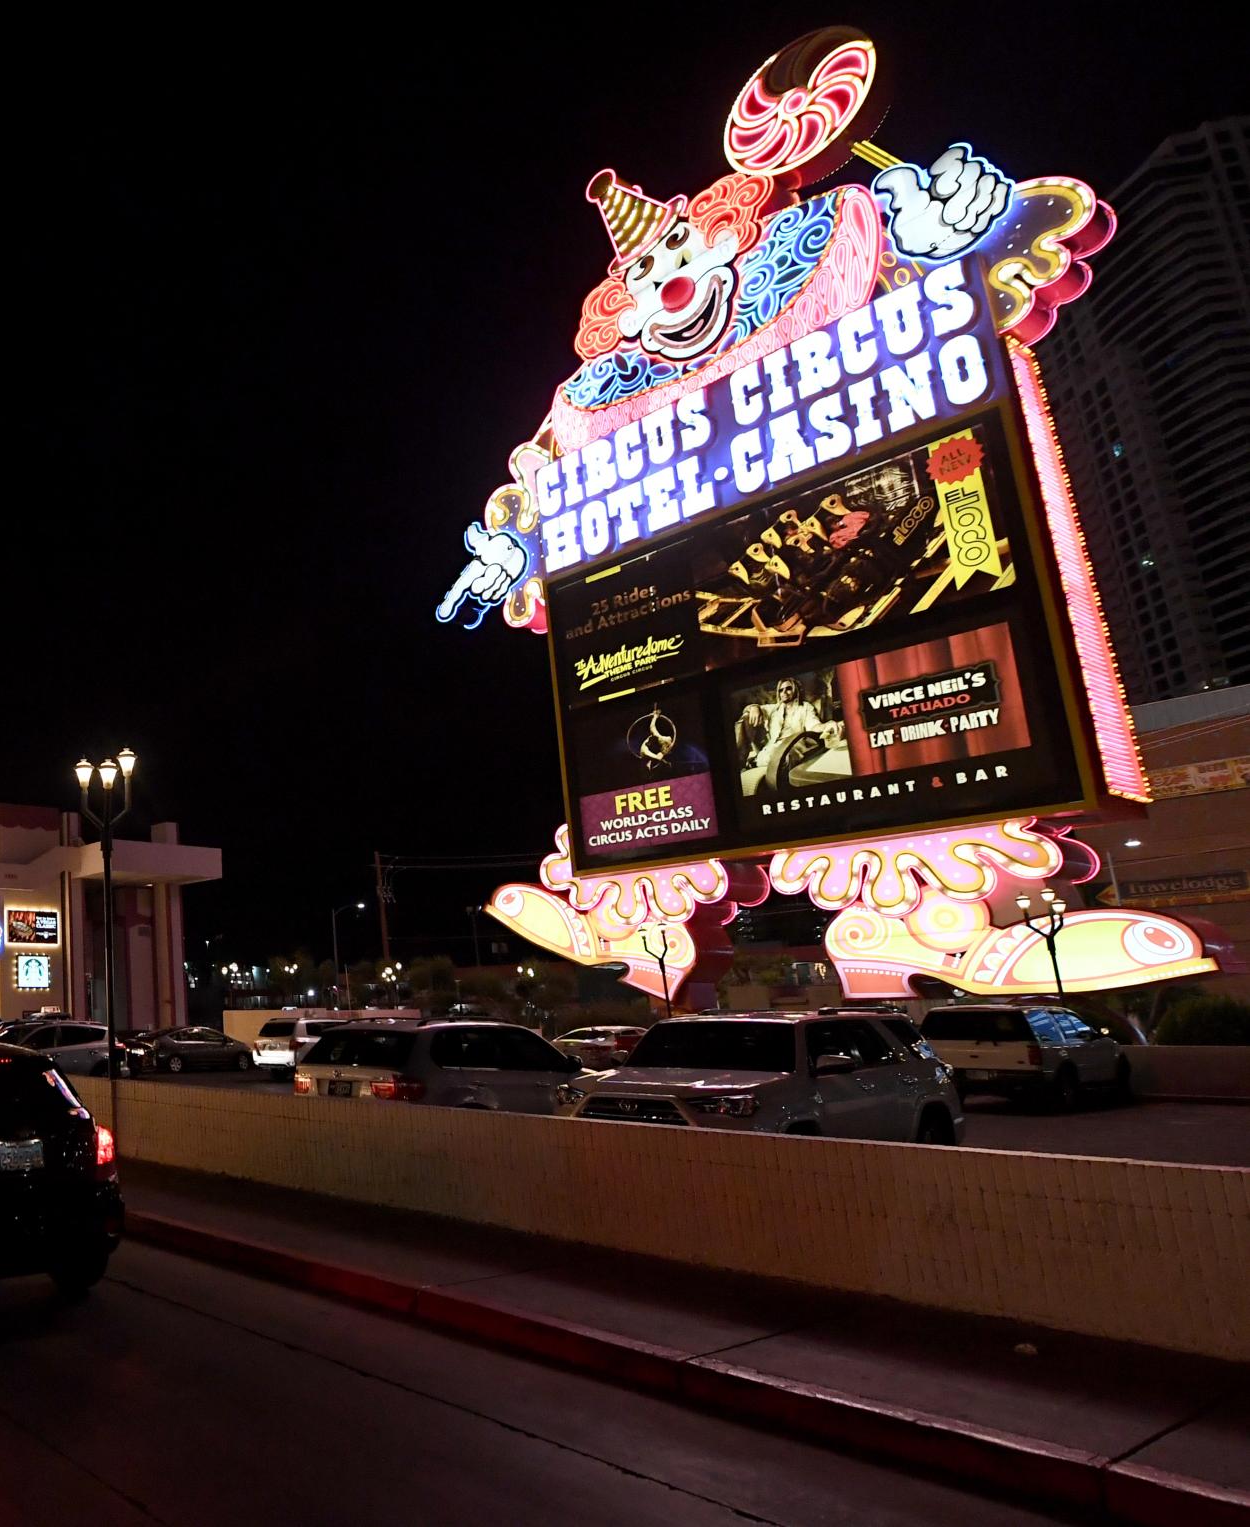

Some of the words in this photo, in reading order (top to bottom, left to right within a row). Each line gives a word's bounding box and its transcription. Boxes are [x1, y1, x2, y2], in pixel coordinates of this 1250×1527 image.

[536, 389, 711, 516] CIRCUS
[730, 261, 975, 425] CIRCUS
[543, 455, 717, 572] HOTEL
[730, 335, 989, 493] CASINO
[939, 454, 971, 475] NEW
[941, 449, 966, 465] ALL
[945, 487, 979, 503] EL
[947, 494, 990, 567] LOCO
[591, 600, 609, 616] 25
[614, 586, 657, 607] Rides
[566, 619, 594, 640] and
[604, 662, 633, 678] THEME
[634, 655, 657, 668] PARK
[610, 672, 630, 682] CIRCUS
[632, 665, 653, 675] CIRCUS
[870, 729, 895, 749] EAT
[900, 719, 946, 742] DRINK
[950, 708, 999, 733] PARTY
[615, 785, 673, 815] FREE
[762, 780, 915, 816] RESTAURANT
[931, 776, 943, 788] &
[956, 765, 1008, 785] BAR
[589, 830, 633, 847] CIRCUS
[636, 824, 668, 839] ACTS
[671, 817, 710, 834] DAILY
[600, 806, 693, 831] WORLD-CLASS
[1131, 876, 1240, 894] Travelodge
